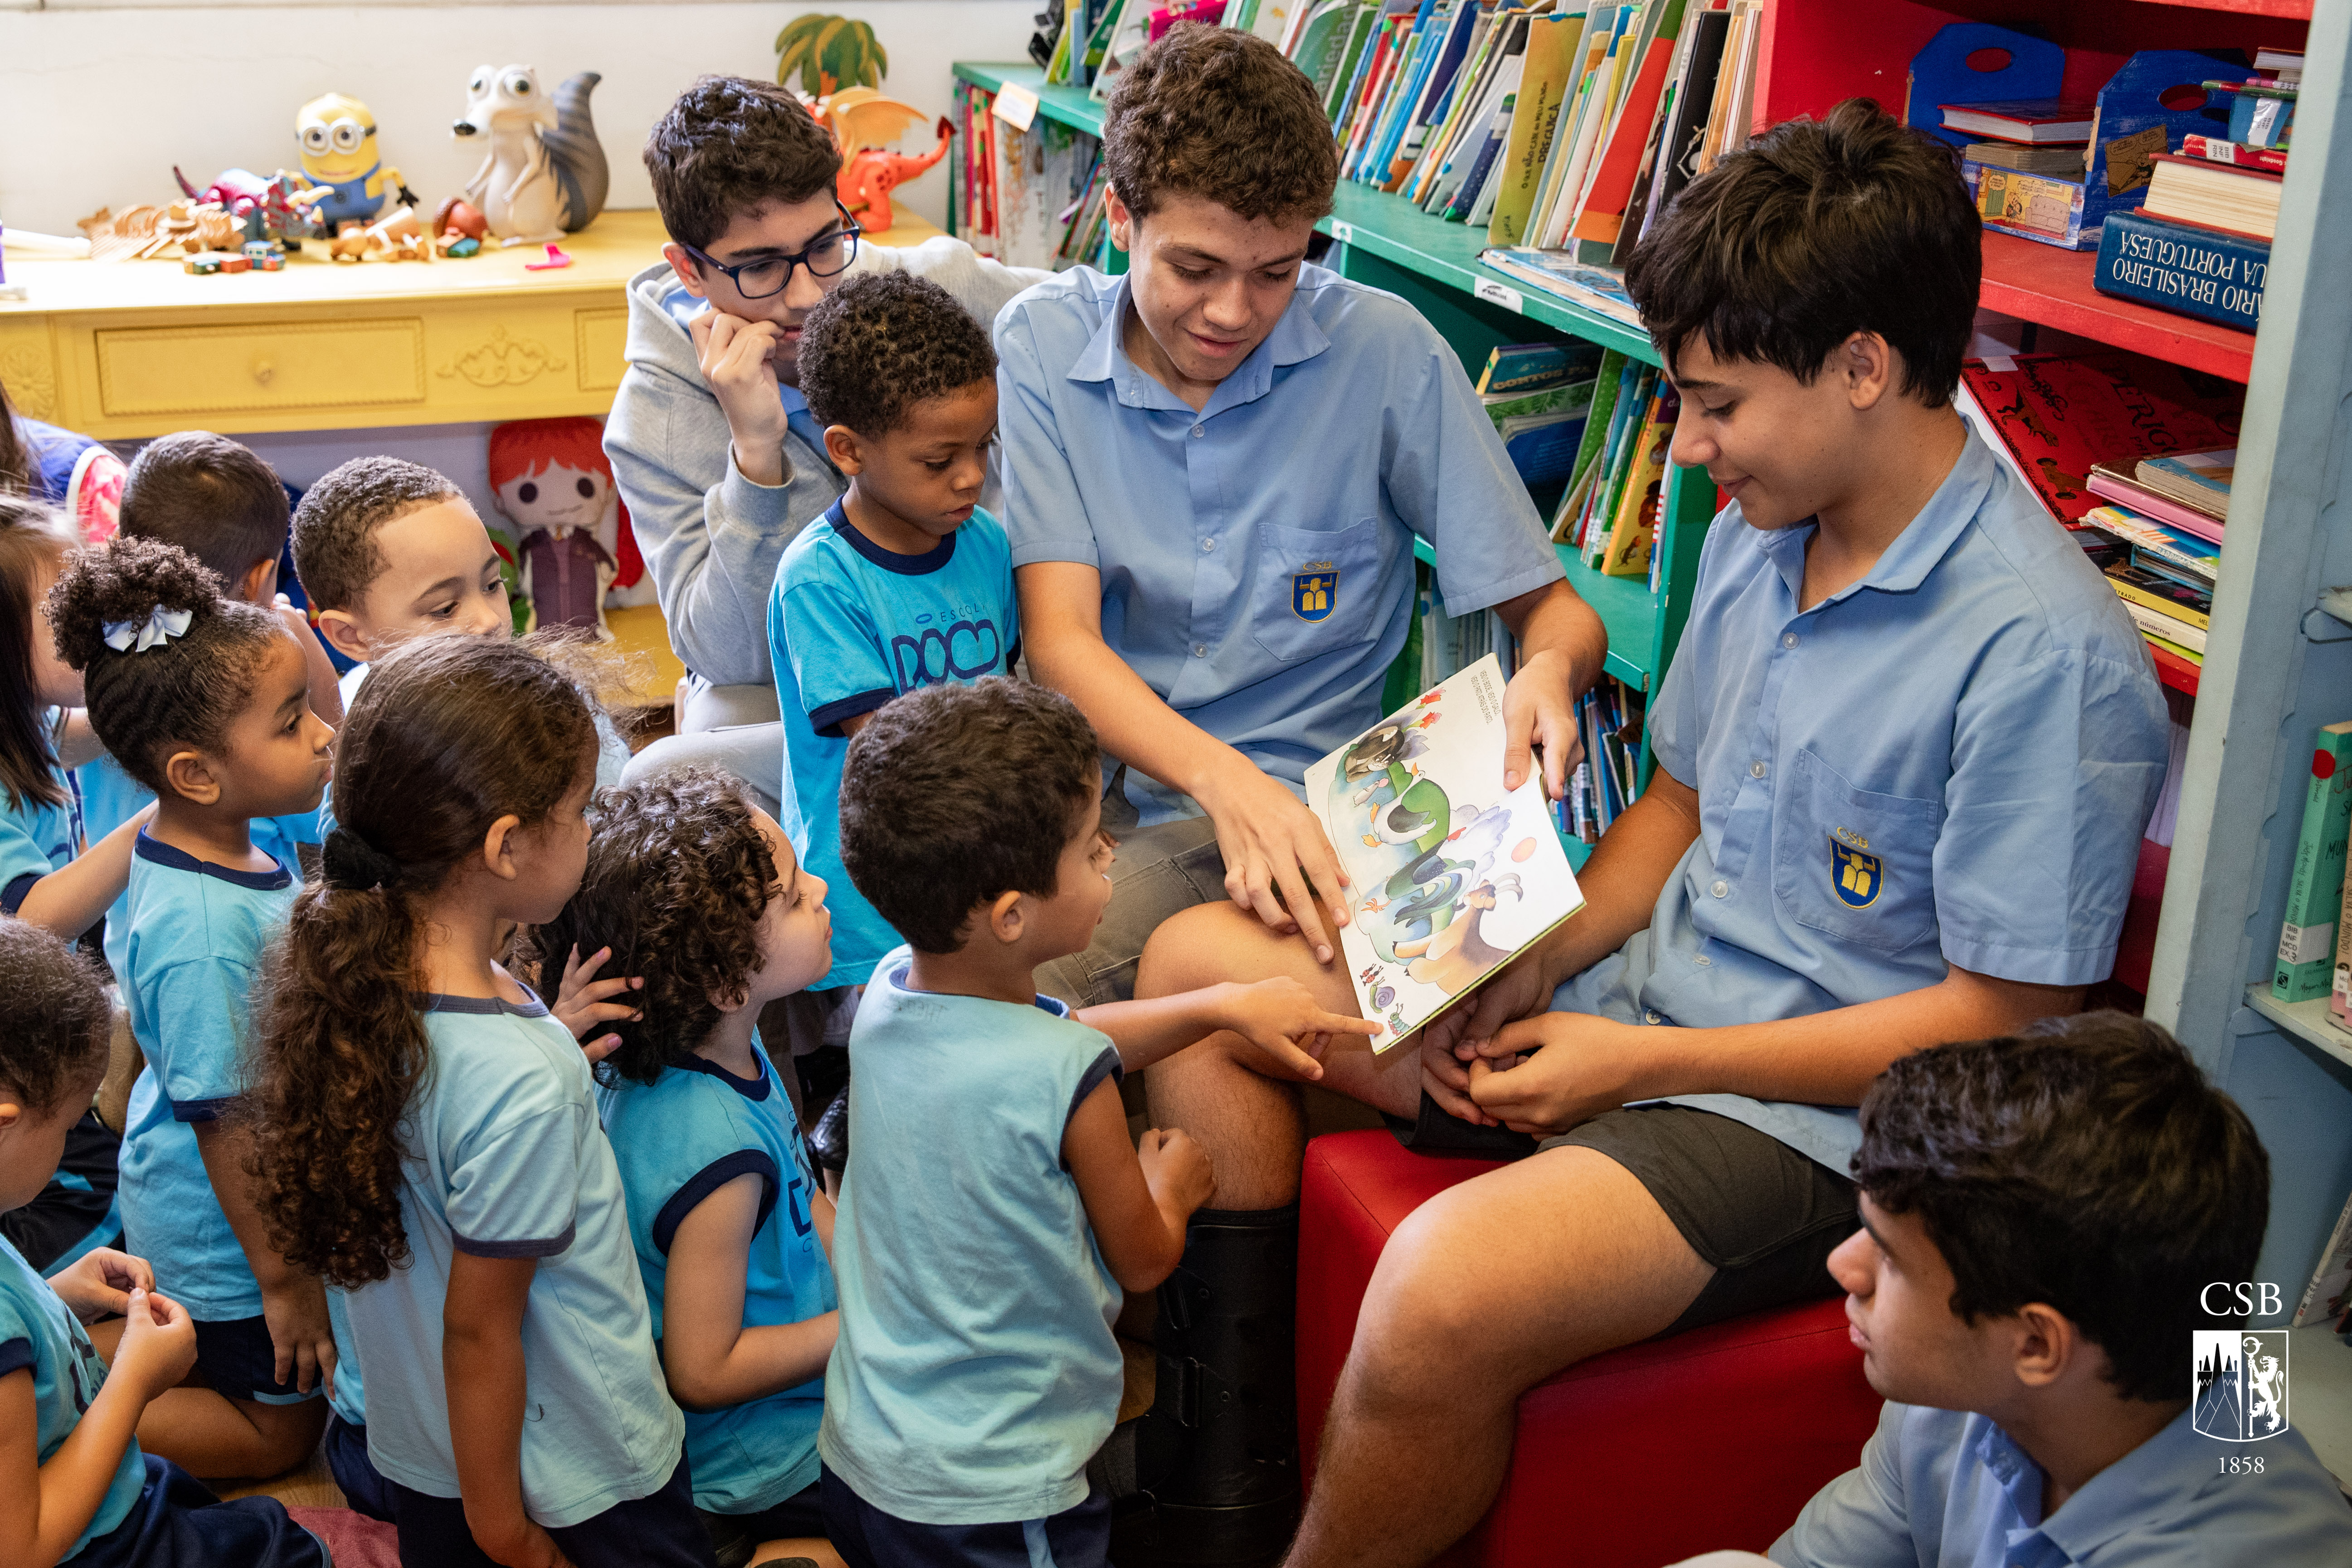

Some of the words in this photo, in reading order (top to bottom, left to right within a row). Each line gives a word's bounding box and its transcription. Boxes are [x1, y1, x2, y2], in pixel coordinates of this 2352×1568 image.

[2121, 231, 2236, 280] PORTUGUESA
[2113, 258, 2218, 305] BRASILEIRO
[1303, 561, 1333, 571] CSB
[940, 603, 985, 622] ESCOL
[2139, 619, 2171, 636] números
[1474, 686, 1482, 696] PATO
[1478, 695, 1487, 707] ATRÁS
[1483, 711, 1493, 725] RATO.
[1483, 680, 1492, 693] BODE,
[1492, 703, 1501, 716] GALO,
[1837, 827, 1869, 849] CSB
[2301, 841, 2313, 856] Judy
[2298, 854, 2310, 876] Moody
[2290, 903, 2299, 925] MUNDO
[2285, 933, 2297, 941] INF
[2287, 925, 2298, 934] BIB
[2281, 940, 2298, 951] MCD
